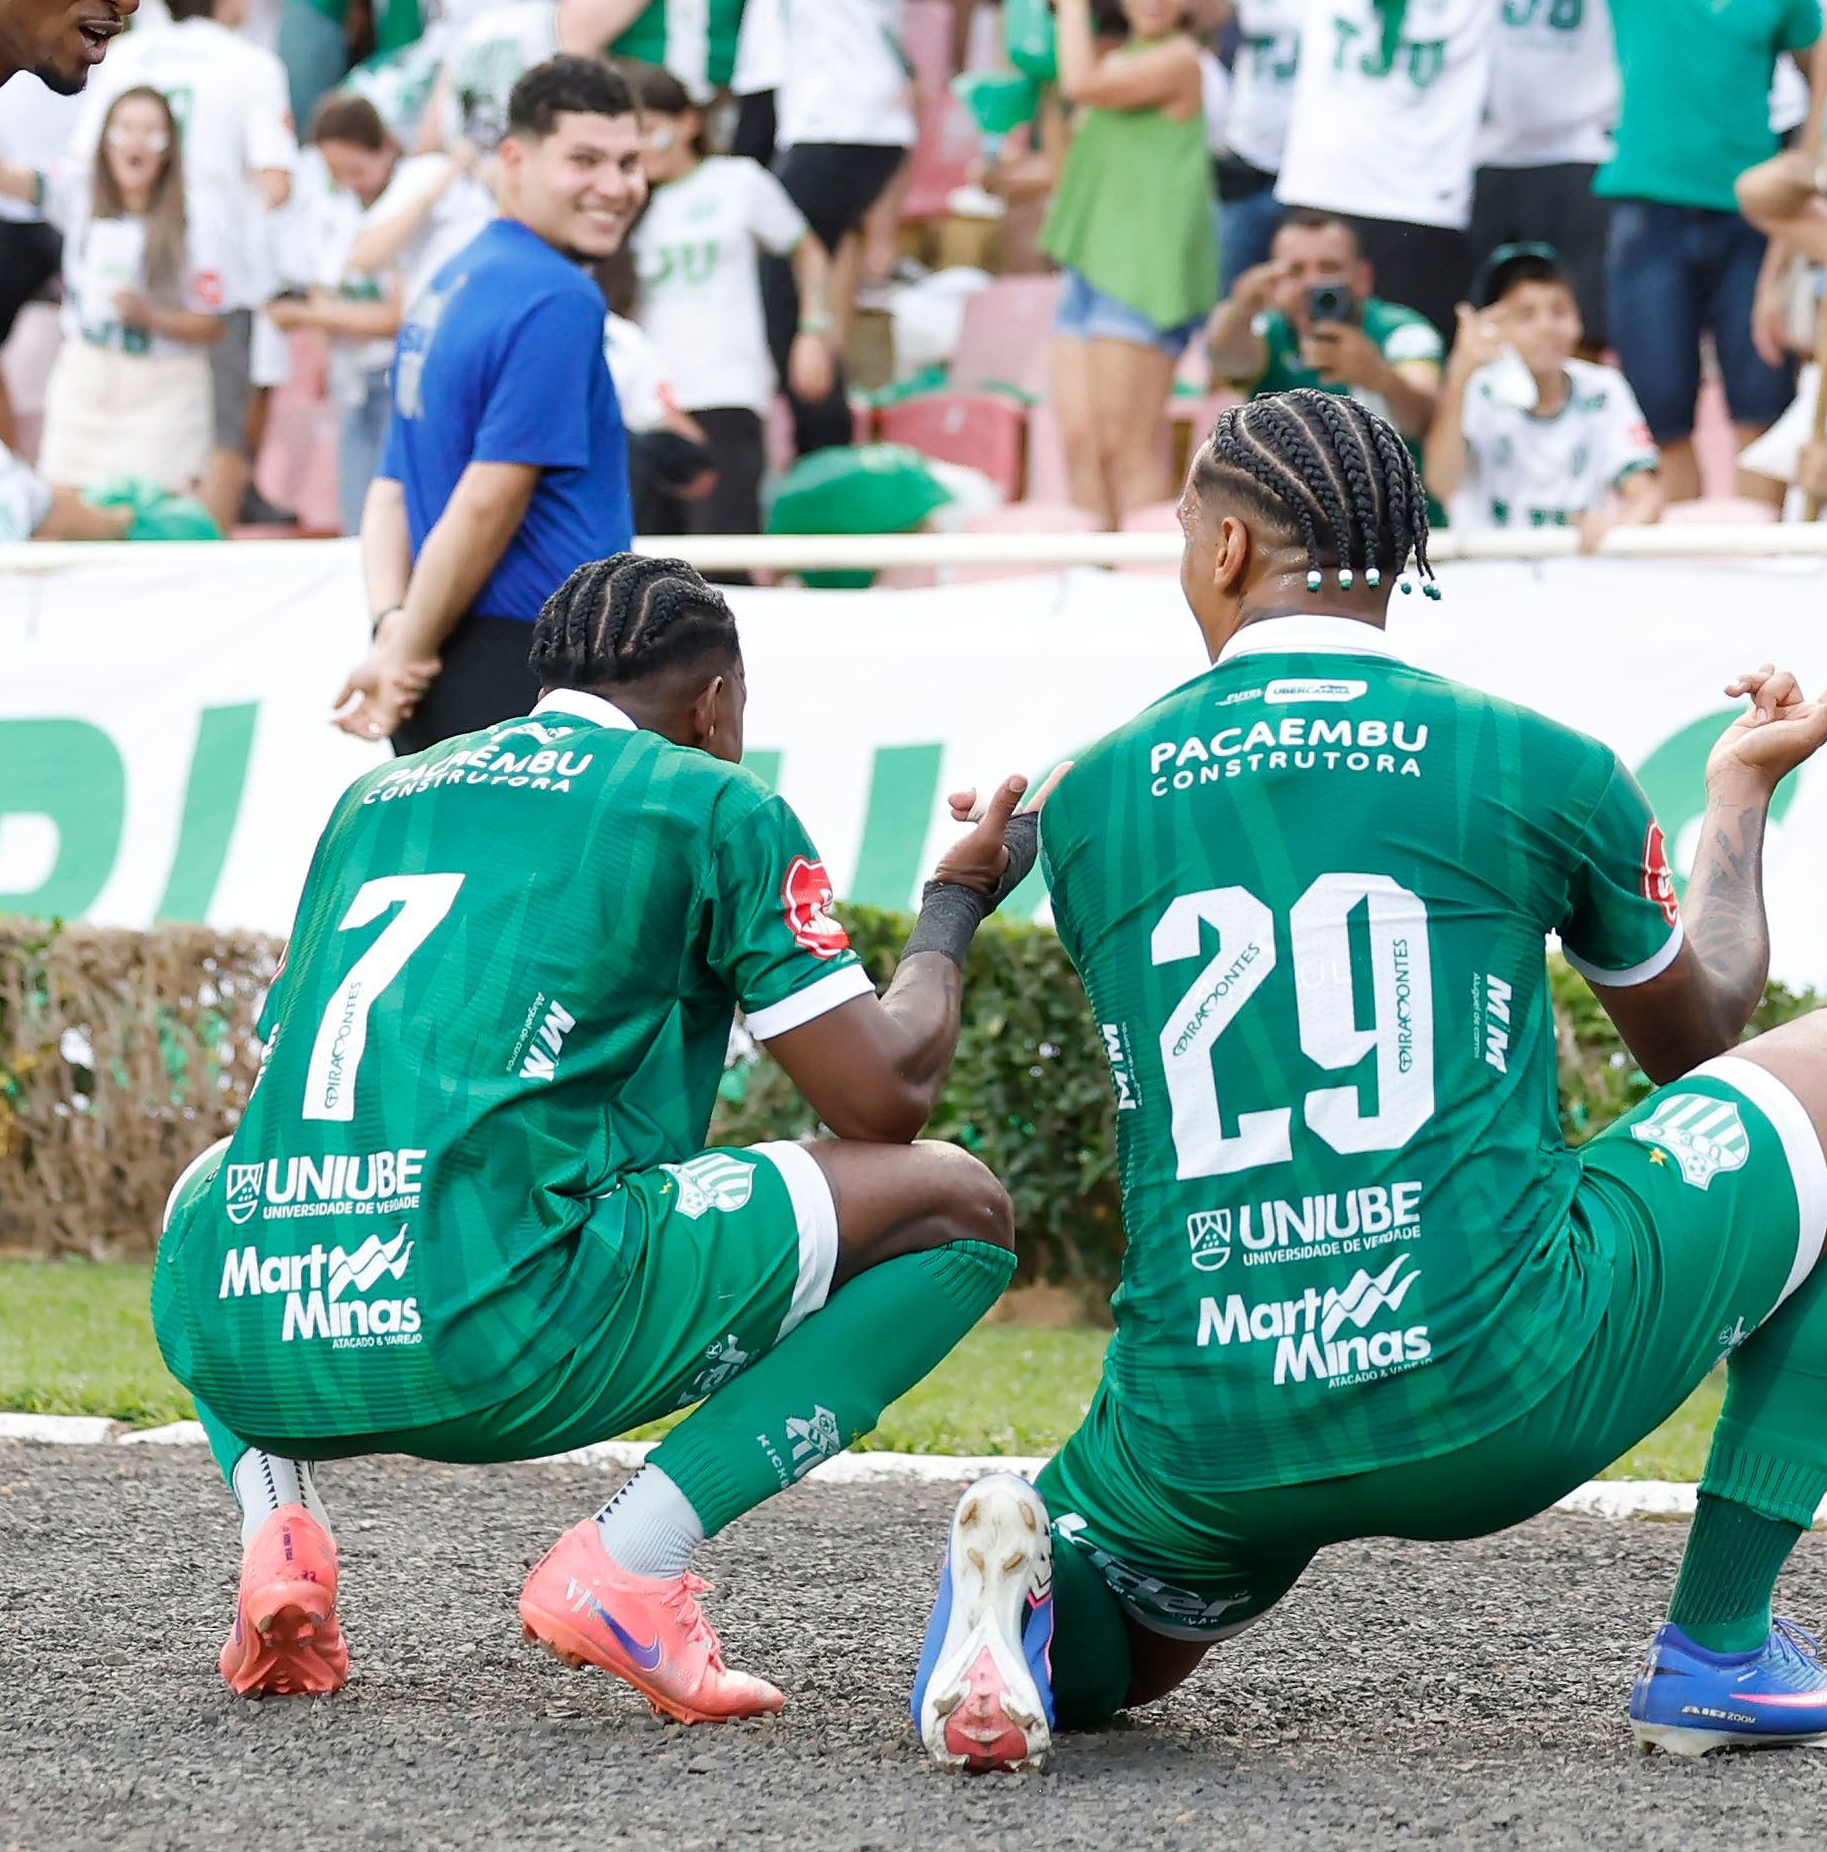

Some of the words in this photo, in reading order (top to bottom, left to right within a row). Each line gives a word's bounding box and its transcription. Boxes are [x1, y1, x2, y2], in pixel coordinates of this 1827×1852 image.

[1150, 718, 1428, 774] PACAEMBU
[363, 769, 571, 805] CONSTRUTORA
[1150, 750, 1421, 797] CONSTRUTORA
[302, 873, 466, 1121] 7
[1151, 871, 1436, 1182] 29
[266, 1149, 427, 1203] UNIUBE
[263, 1201, 353, 1219] UNIVERSIDADE
[356, 1201, 374, 1214] DE
[1239, 1181, 1422, 1250] UNIUBE
[219, 1245, 328, 1299] Mart
[1243, 1242, 1341, 1266] UNIVERSIDADE
[1344, 1238, 1360, 1253] DE
[282, 1290, 421, 1341] Minas
[332, 1337, 374, 1349] ATACADO
[386, 1334, 422, 1346] VAREJO
[1196, 1287, 1322, 1346] Mart
[1274, 1325, 1431, 1385] Minas
[1328, 1371, 1378, 1389] ATACADO
